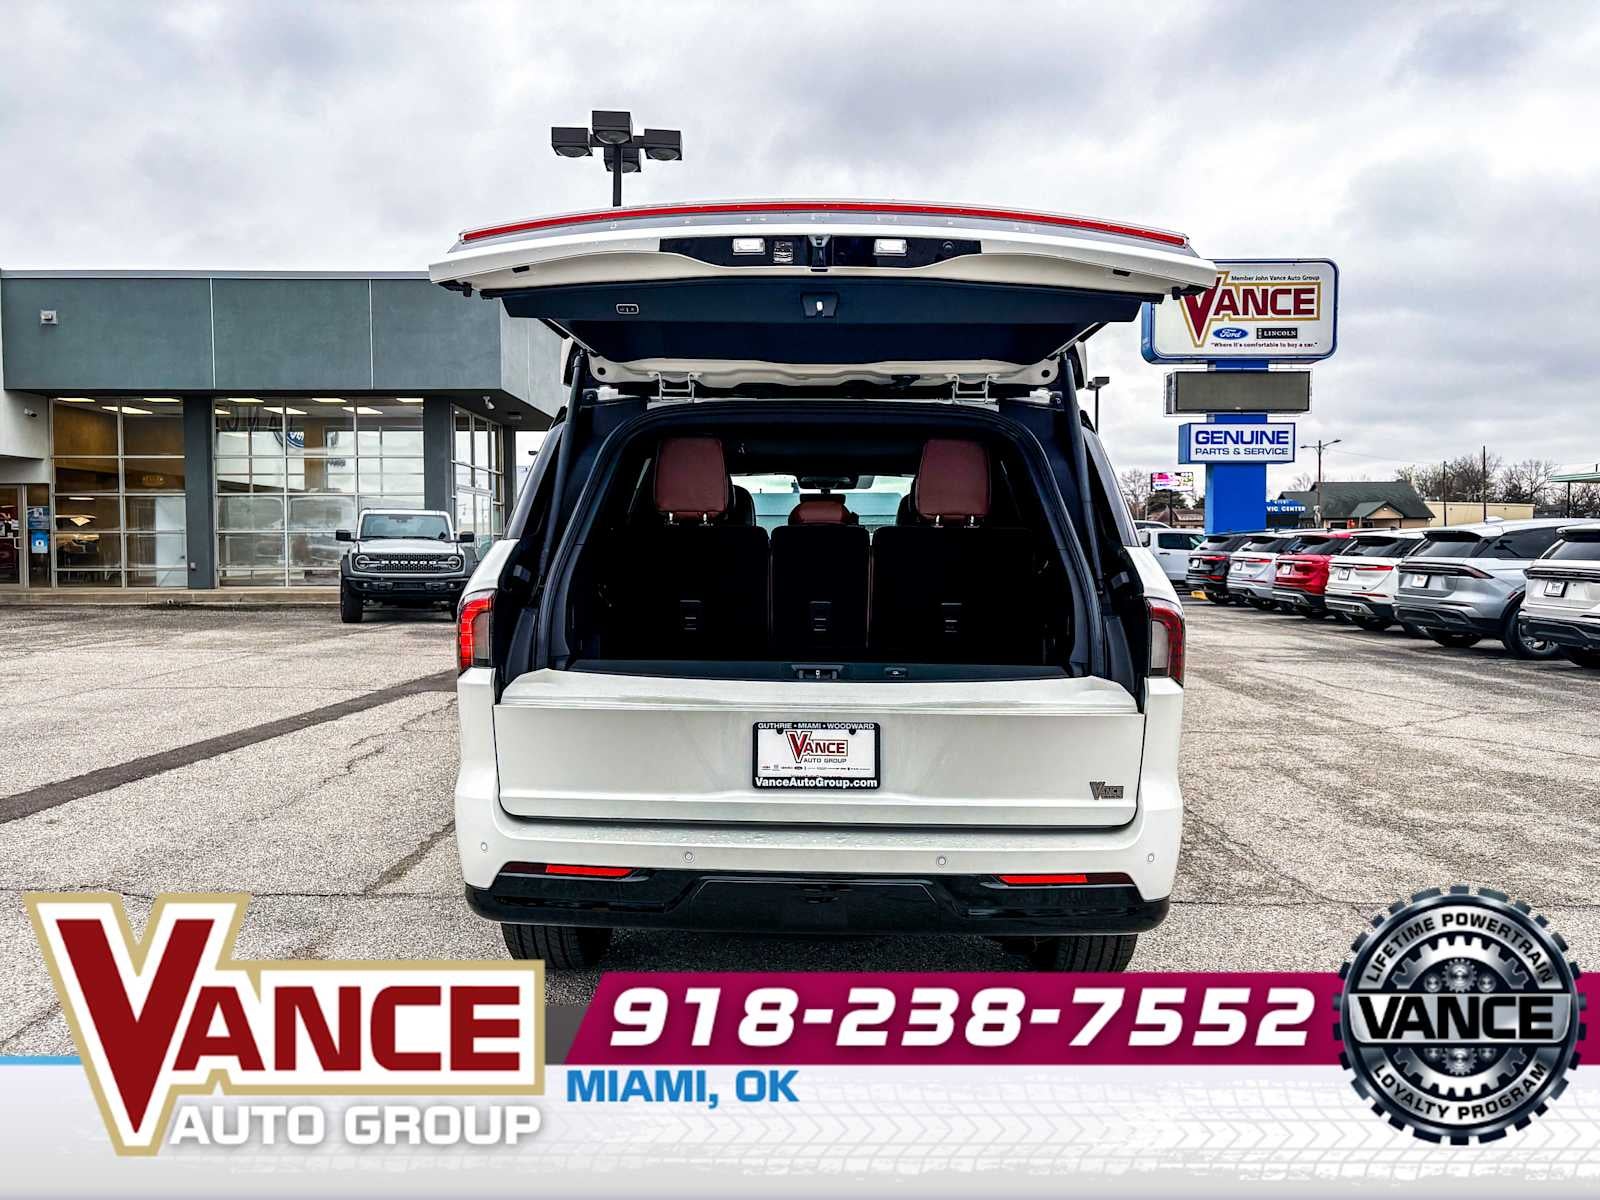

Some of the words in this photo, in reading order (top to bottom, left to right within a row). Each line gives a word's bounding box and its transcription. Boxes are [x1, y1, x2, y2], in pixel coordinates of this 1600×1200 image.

[1184, 276, 1315, 340] VANCE
[1195, 430, 1289, 445] GENUINE
[788, 733, 846, 760] VANCE
[755, 777, 878, 788] VanceAutoGroup.com
